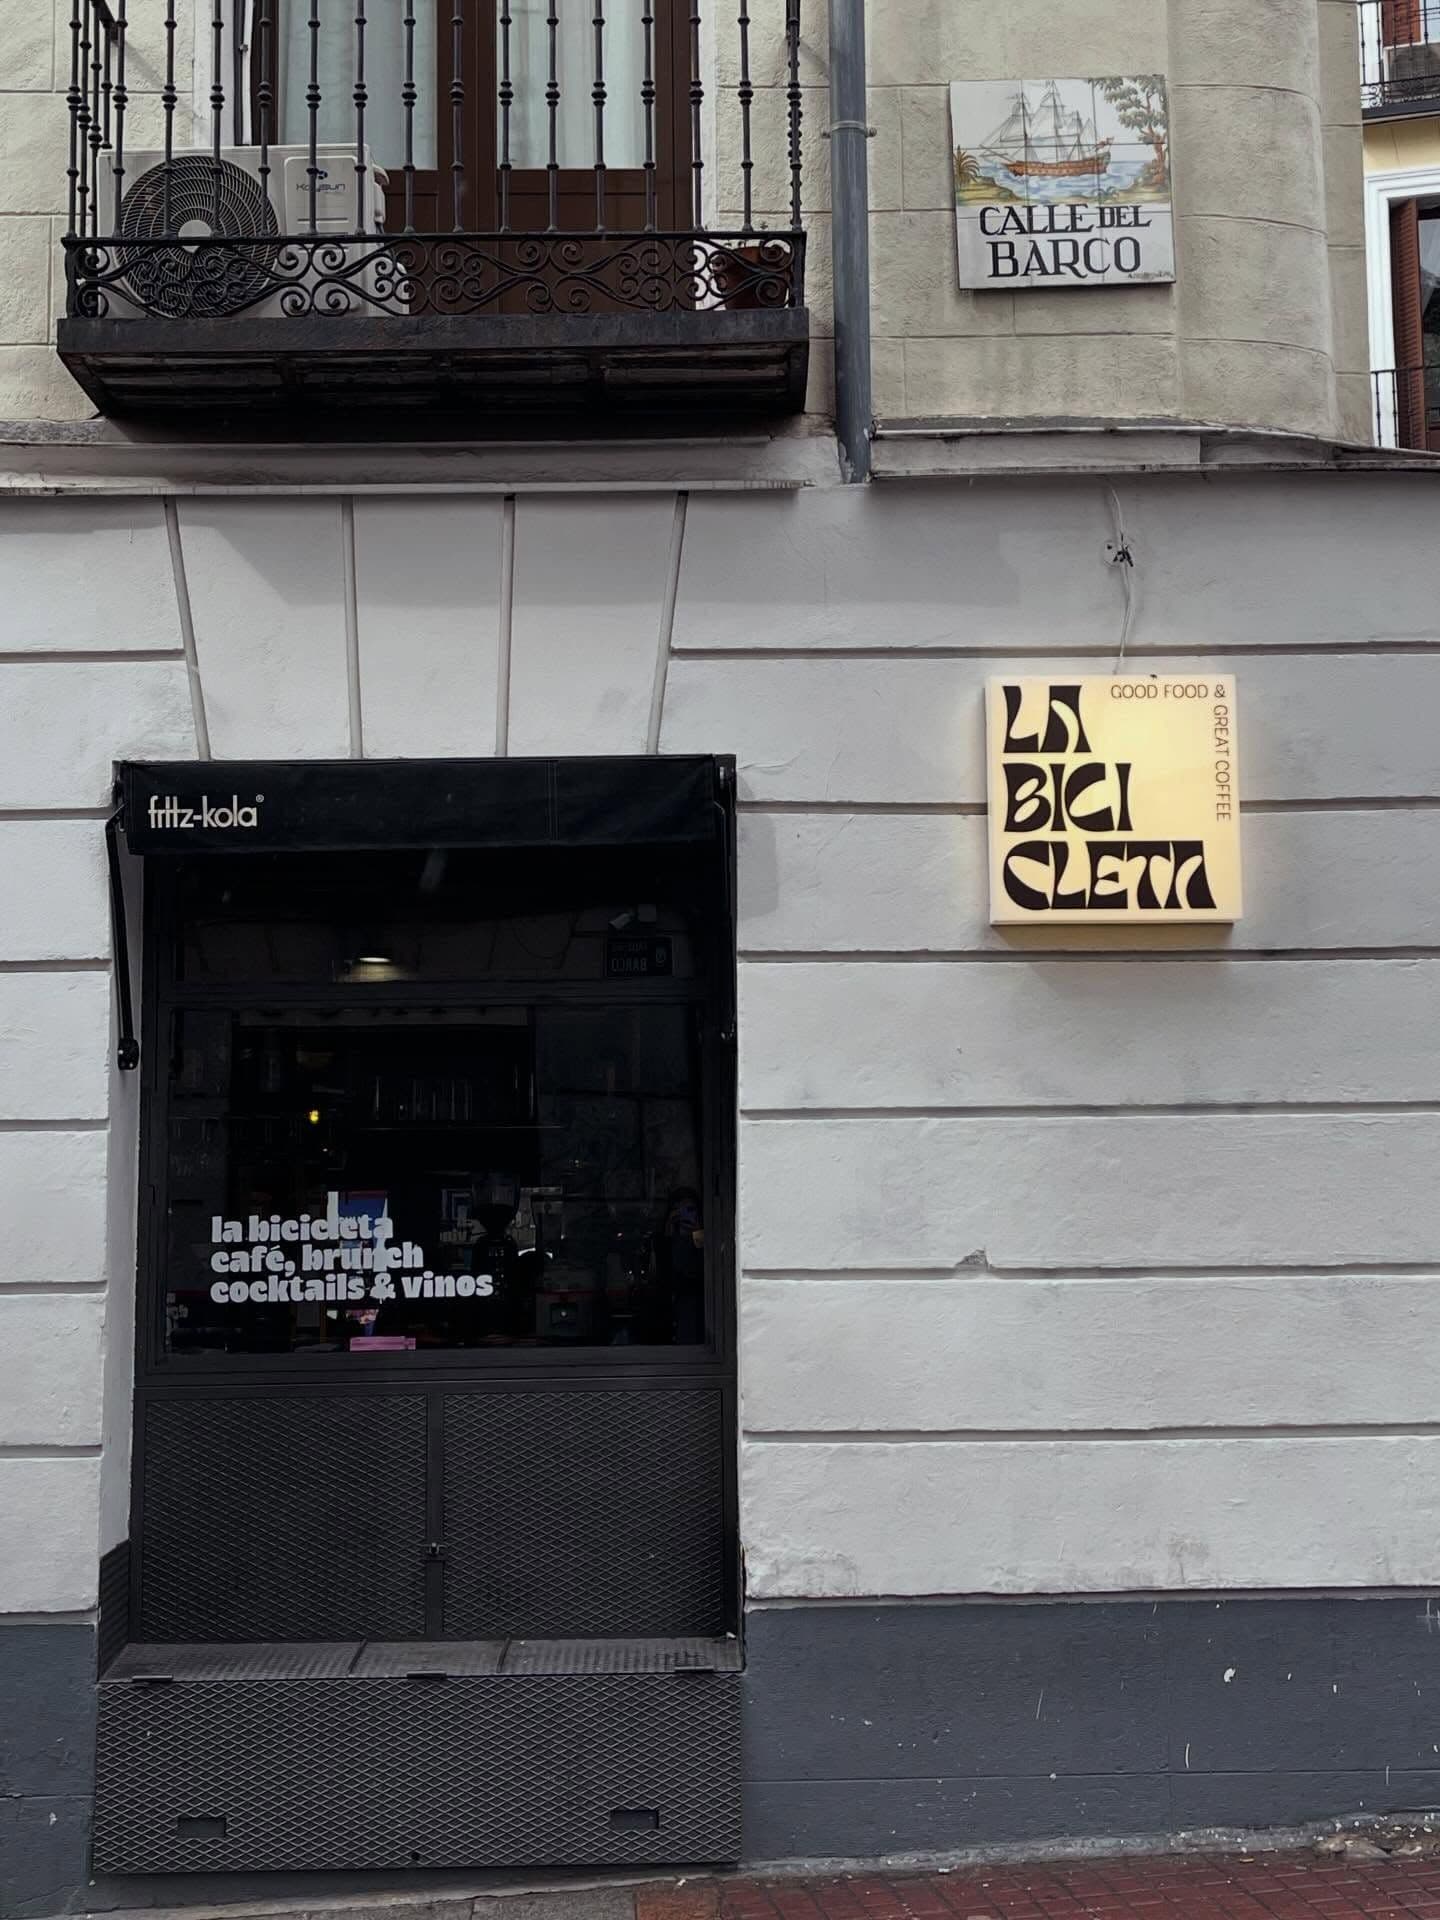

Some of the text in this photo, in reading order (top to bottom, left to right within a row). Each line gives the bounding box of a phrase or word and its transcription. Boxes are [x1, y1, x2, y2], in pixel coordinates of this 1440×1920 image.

[980, 203, 1152, 236] CALLE DEL
[987, 236, 1141, 279] BARCO
[1110, 684, 1226, 699] GOOD FOOD &
[1002, 685, 1093, 753] LA
[1213, 704, 1232, 822] GREAT COFFEE
[1002, 762, 1134, 833] BICI
[1003, 840, 1218, 911] CLETA
[211, 1213, 394, 1243] la bicicleta
[210, 1241, 424, 1278] café, brunch
[210, 1270, 495, 1303] cocktails & vinos
